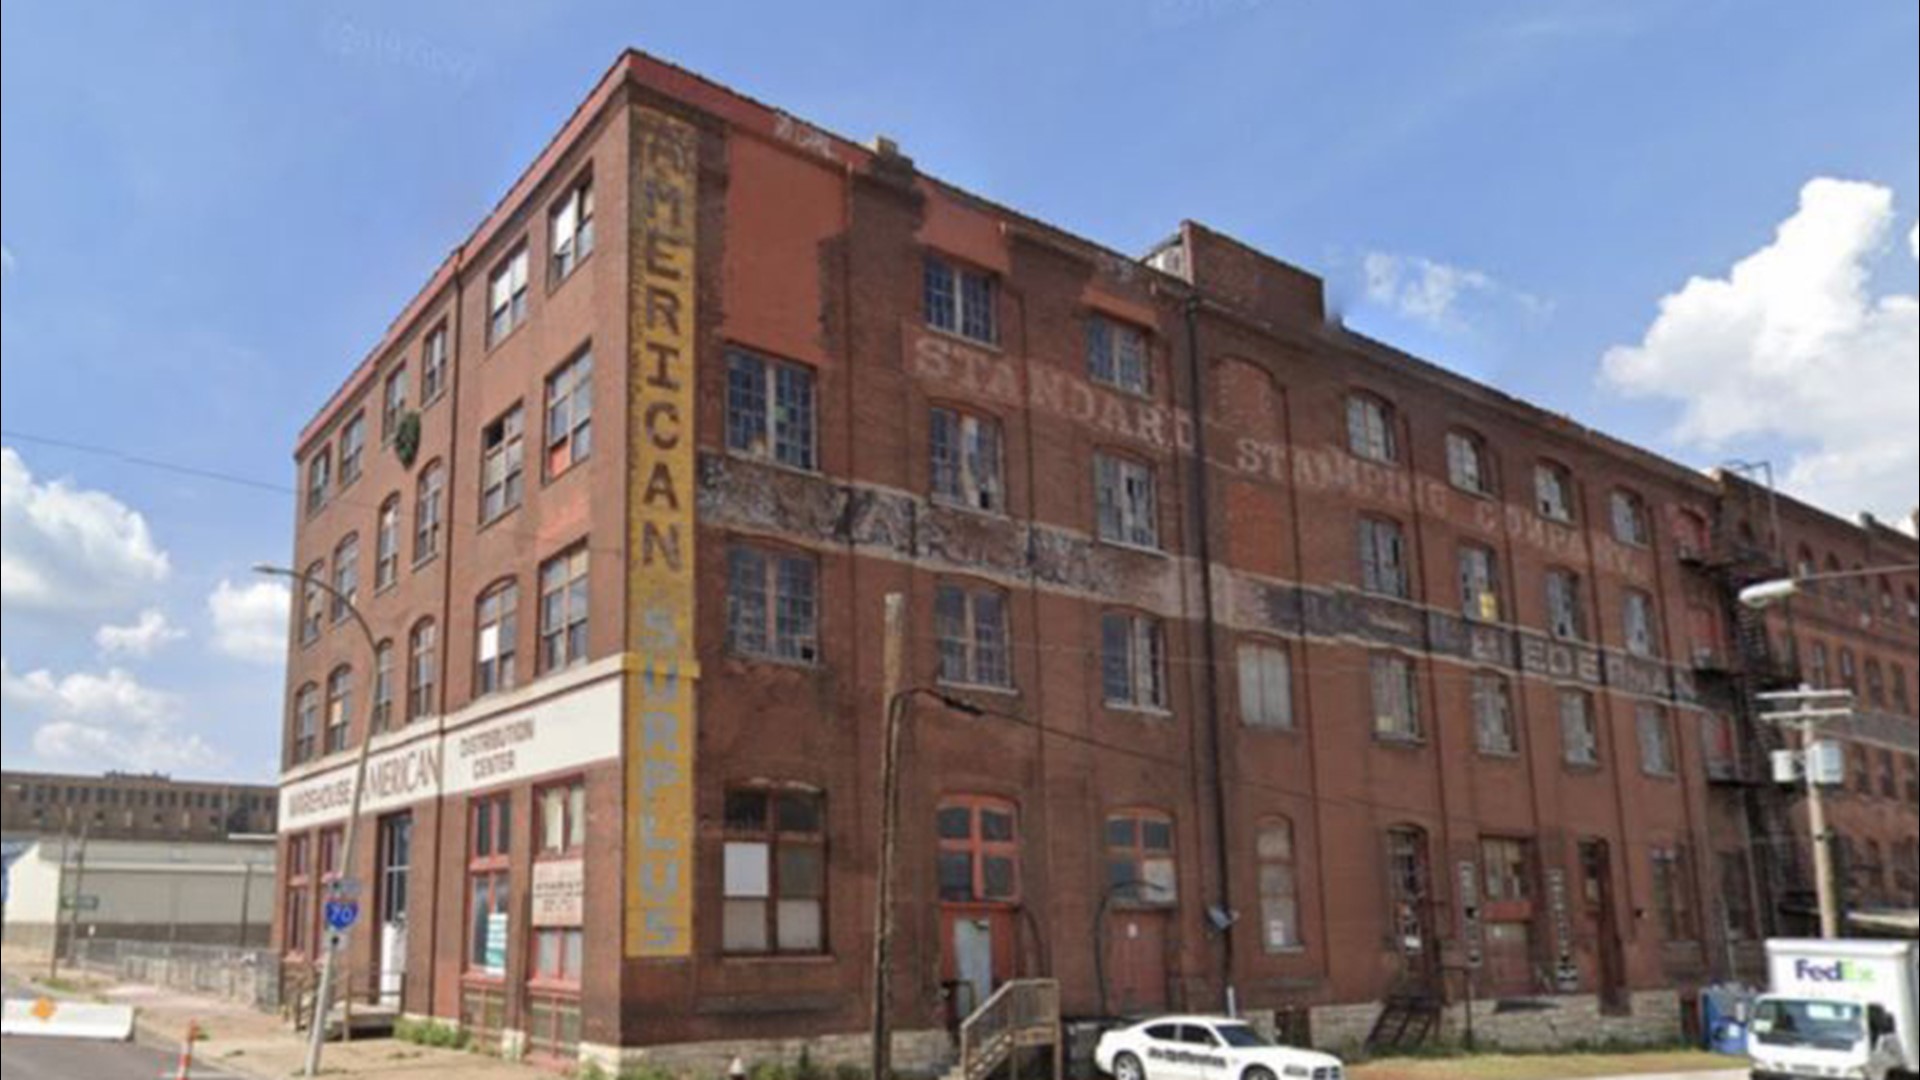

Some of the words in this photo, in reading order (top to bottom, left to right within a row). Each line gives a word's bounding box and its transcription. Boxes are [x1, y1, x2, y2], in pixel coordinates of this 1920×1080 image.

[643, 128, 684, 570] AMERICAN
[914, 335, 1196, 452] STANDARD
[1235, 437, 1449, 516] STAMPING
[458, 717, 535, 759] DISTRIBUTION
[472, 751, 516, 780] CENTER
[640, 603, 679, 948] SURPLUS
[1795, 958, 1875, 982] FedEx
